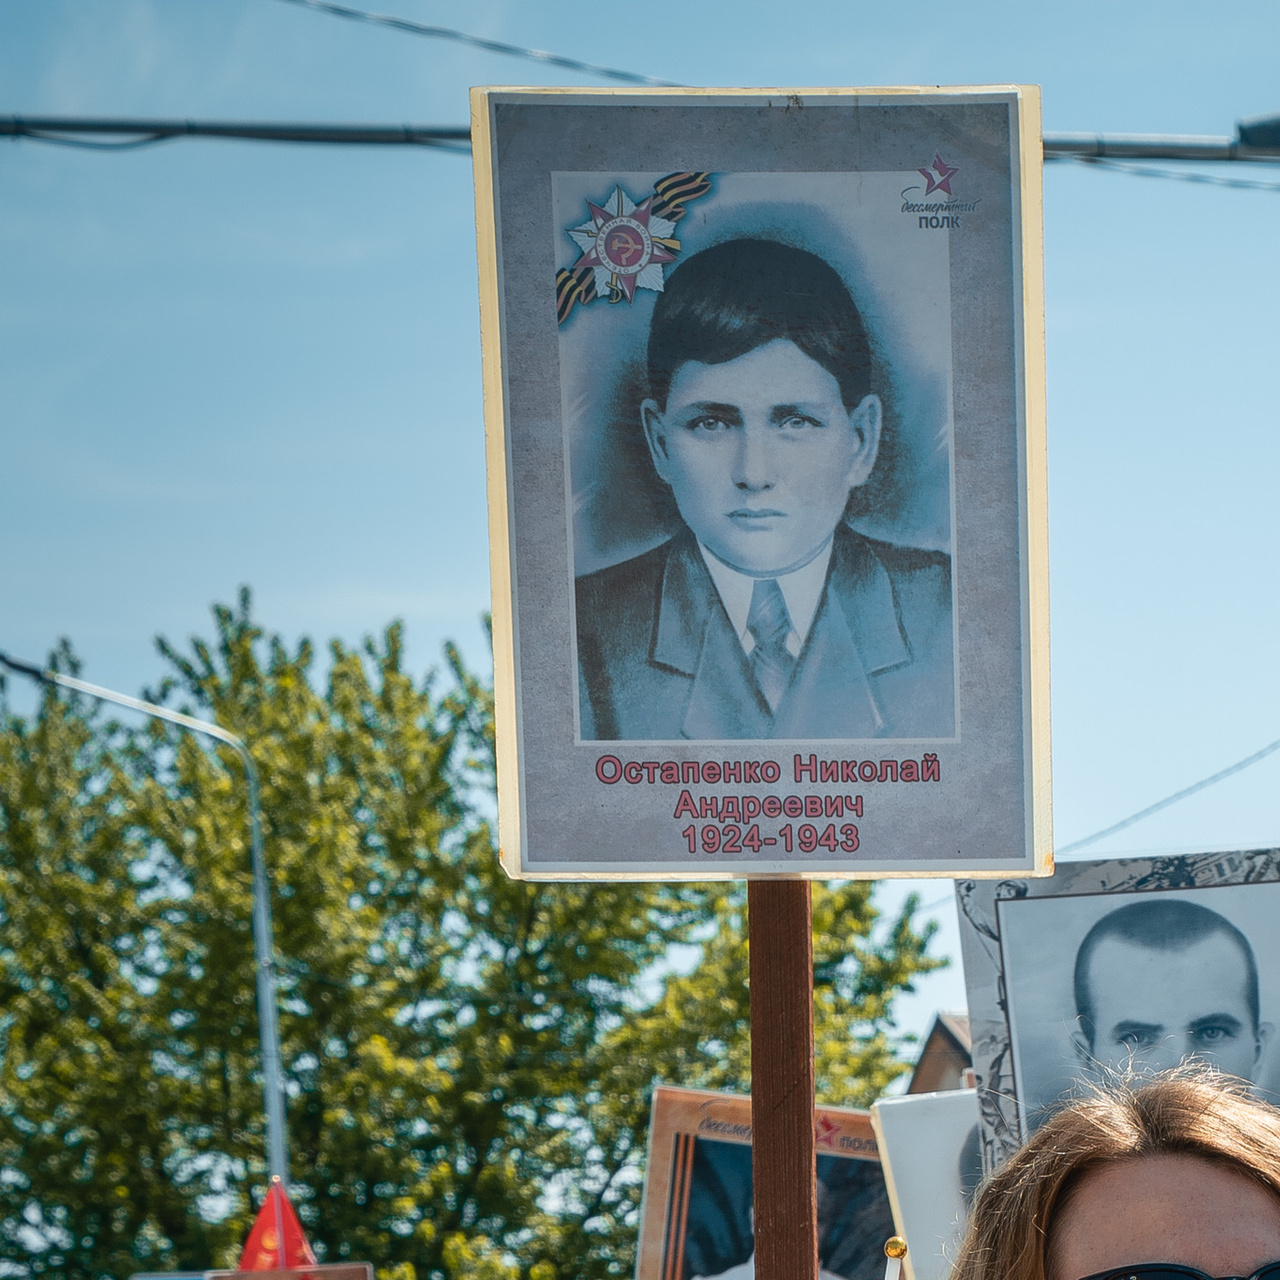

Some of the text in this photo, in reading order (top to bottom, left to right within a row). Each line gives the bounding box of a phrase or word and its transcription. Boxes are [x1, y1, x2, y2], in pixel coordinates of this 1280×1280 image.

[918, 216, 961, 229] ПОЛК
[595, 753, 941, 784] Остапенко Николай
[674, 790, 864, 824] Андреевич
[682, 823, 860, 853] 1924-1943
